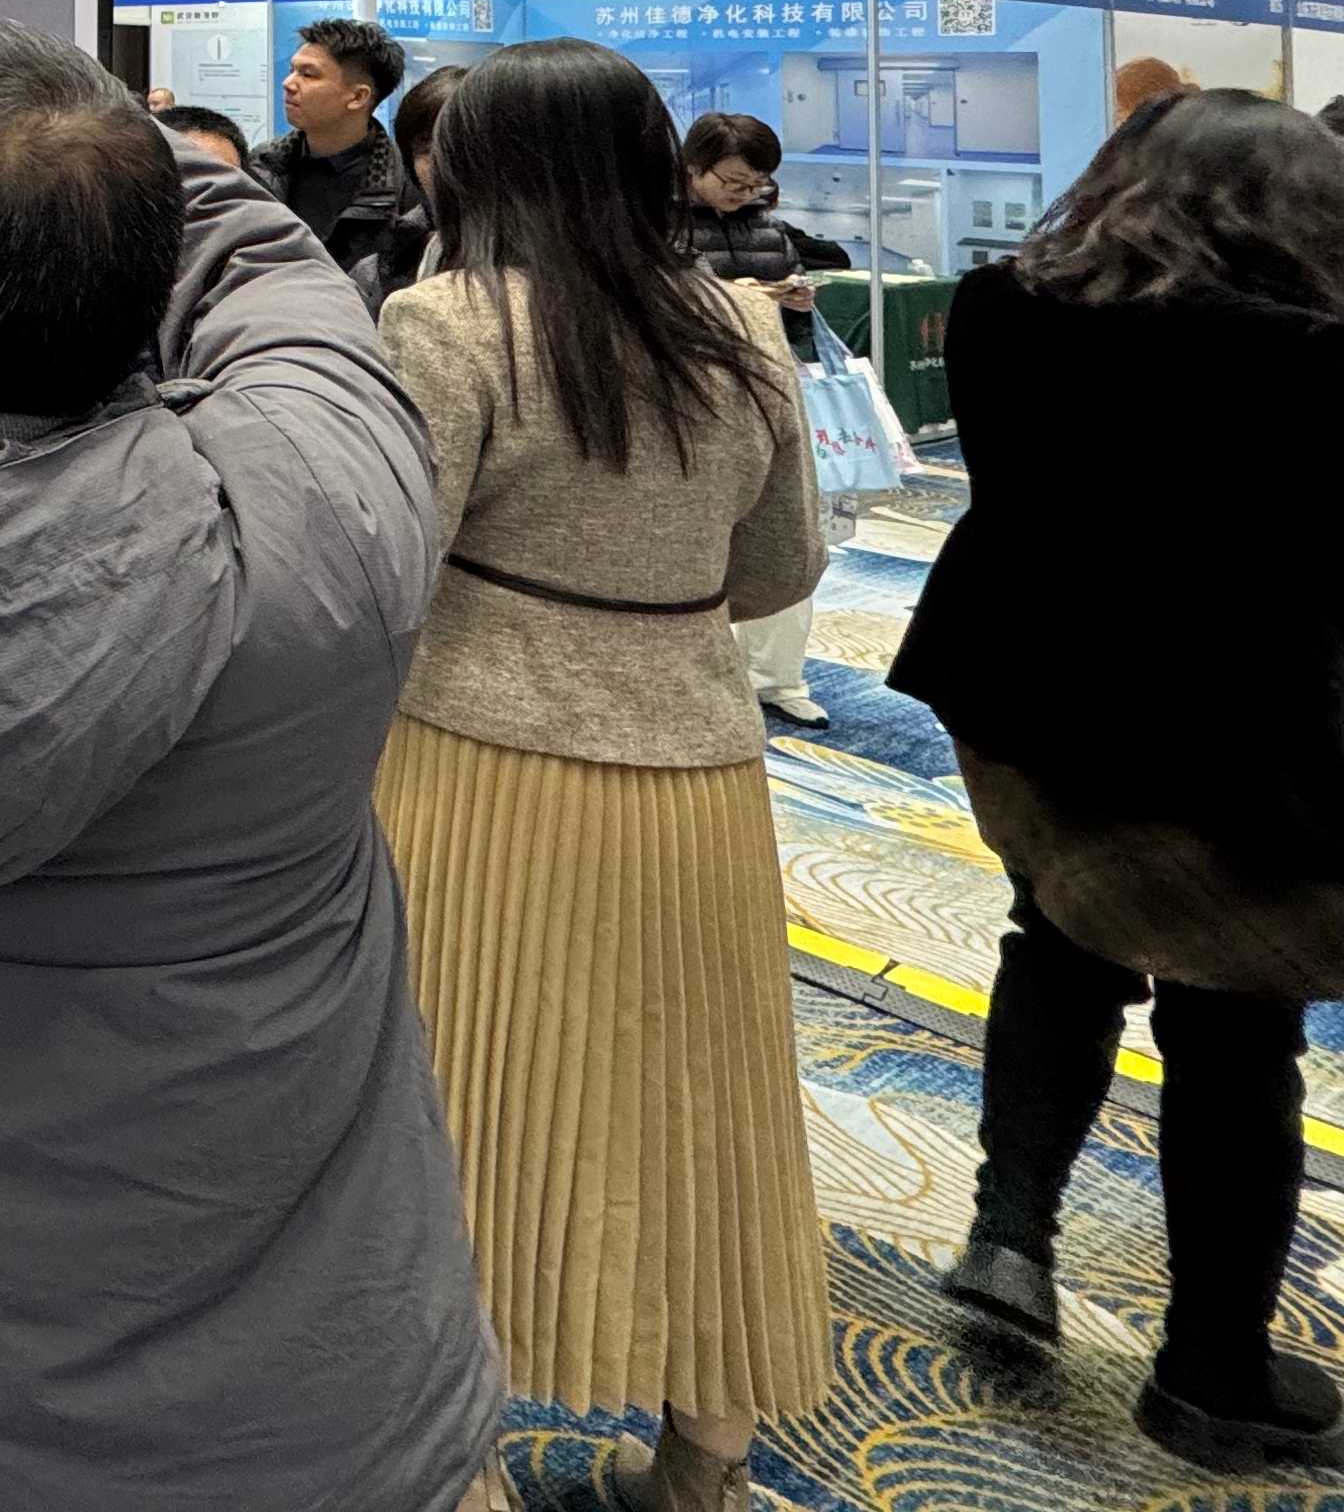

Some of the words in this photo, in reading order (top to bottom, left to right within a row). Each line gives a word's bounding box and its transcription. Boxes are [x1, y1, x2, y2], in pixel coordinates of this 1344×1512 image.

[595, 0, 929, 26] 苏州佳德净化科技有限公司
